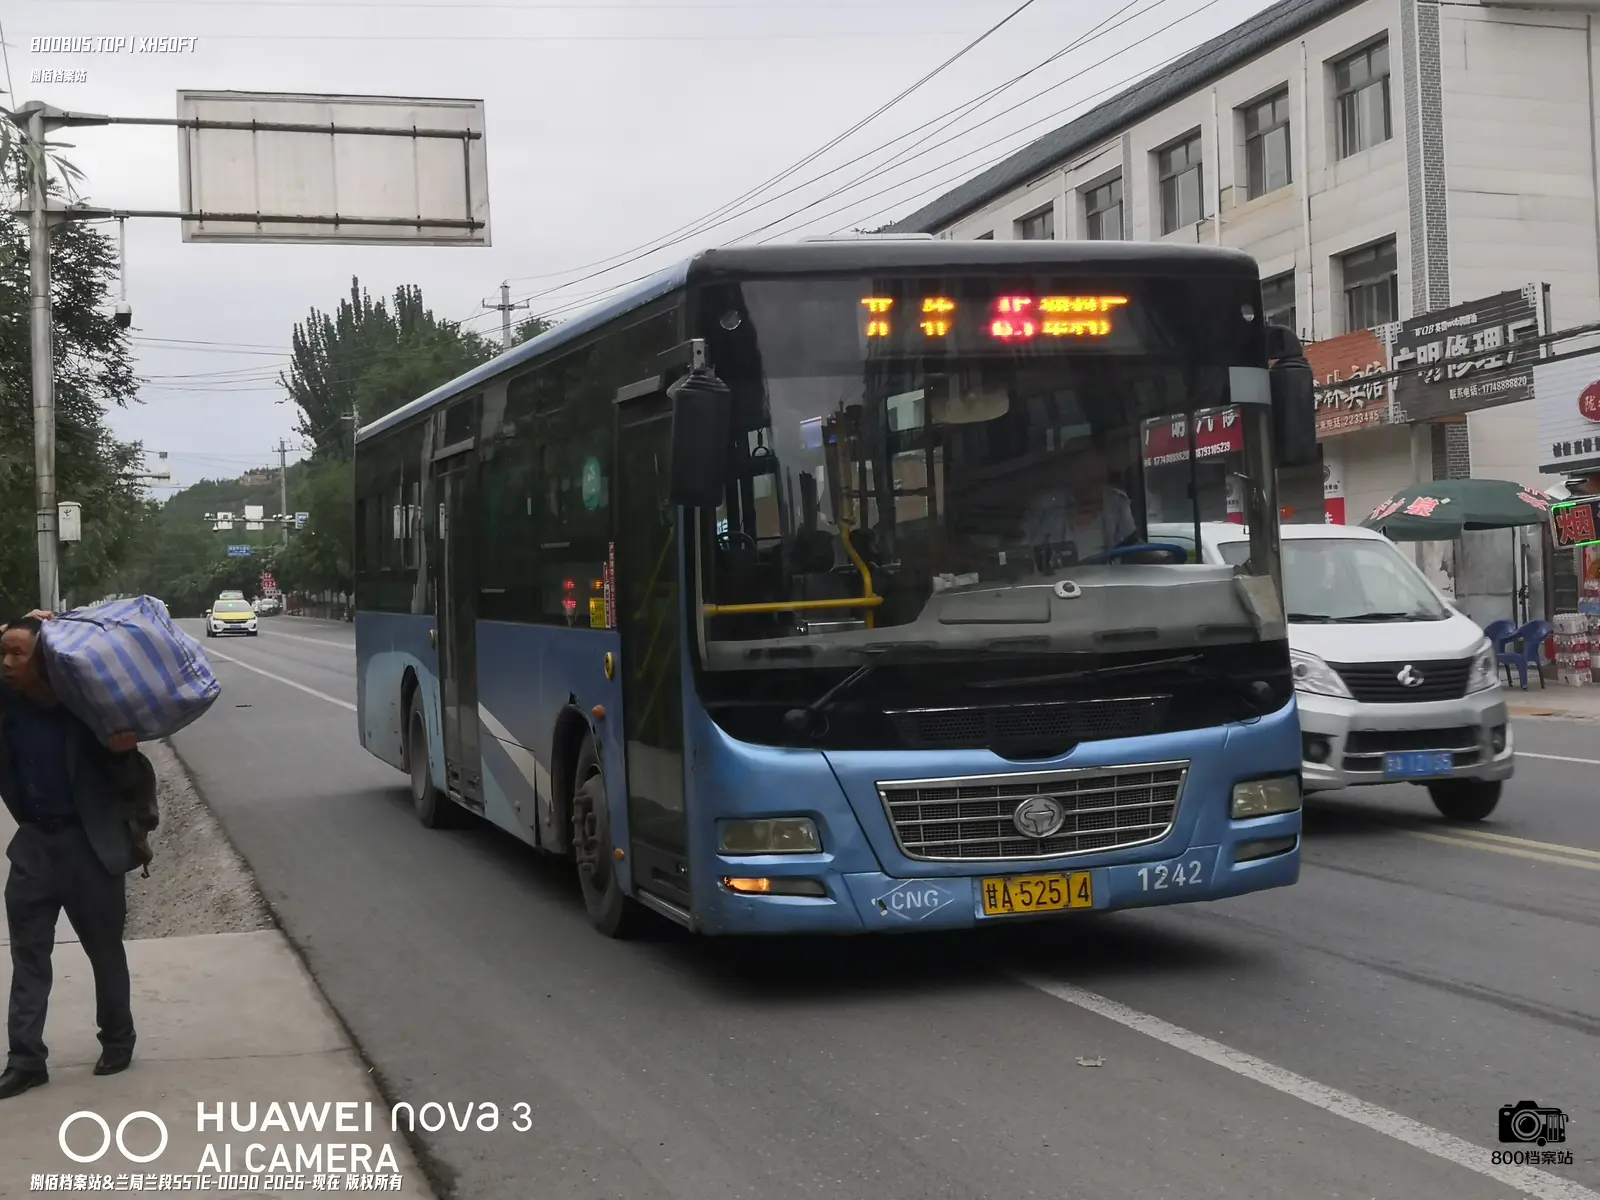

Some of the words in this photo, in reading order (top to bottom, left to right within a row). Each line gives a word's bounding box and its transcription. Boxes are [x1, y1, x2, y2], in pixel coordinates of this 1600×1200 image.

[1557, 504, 1600, 546] 烟
[1136, 860, 1203, 892] 1242
[890, 889, 939, 910] CNG
